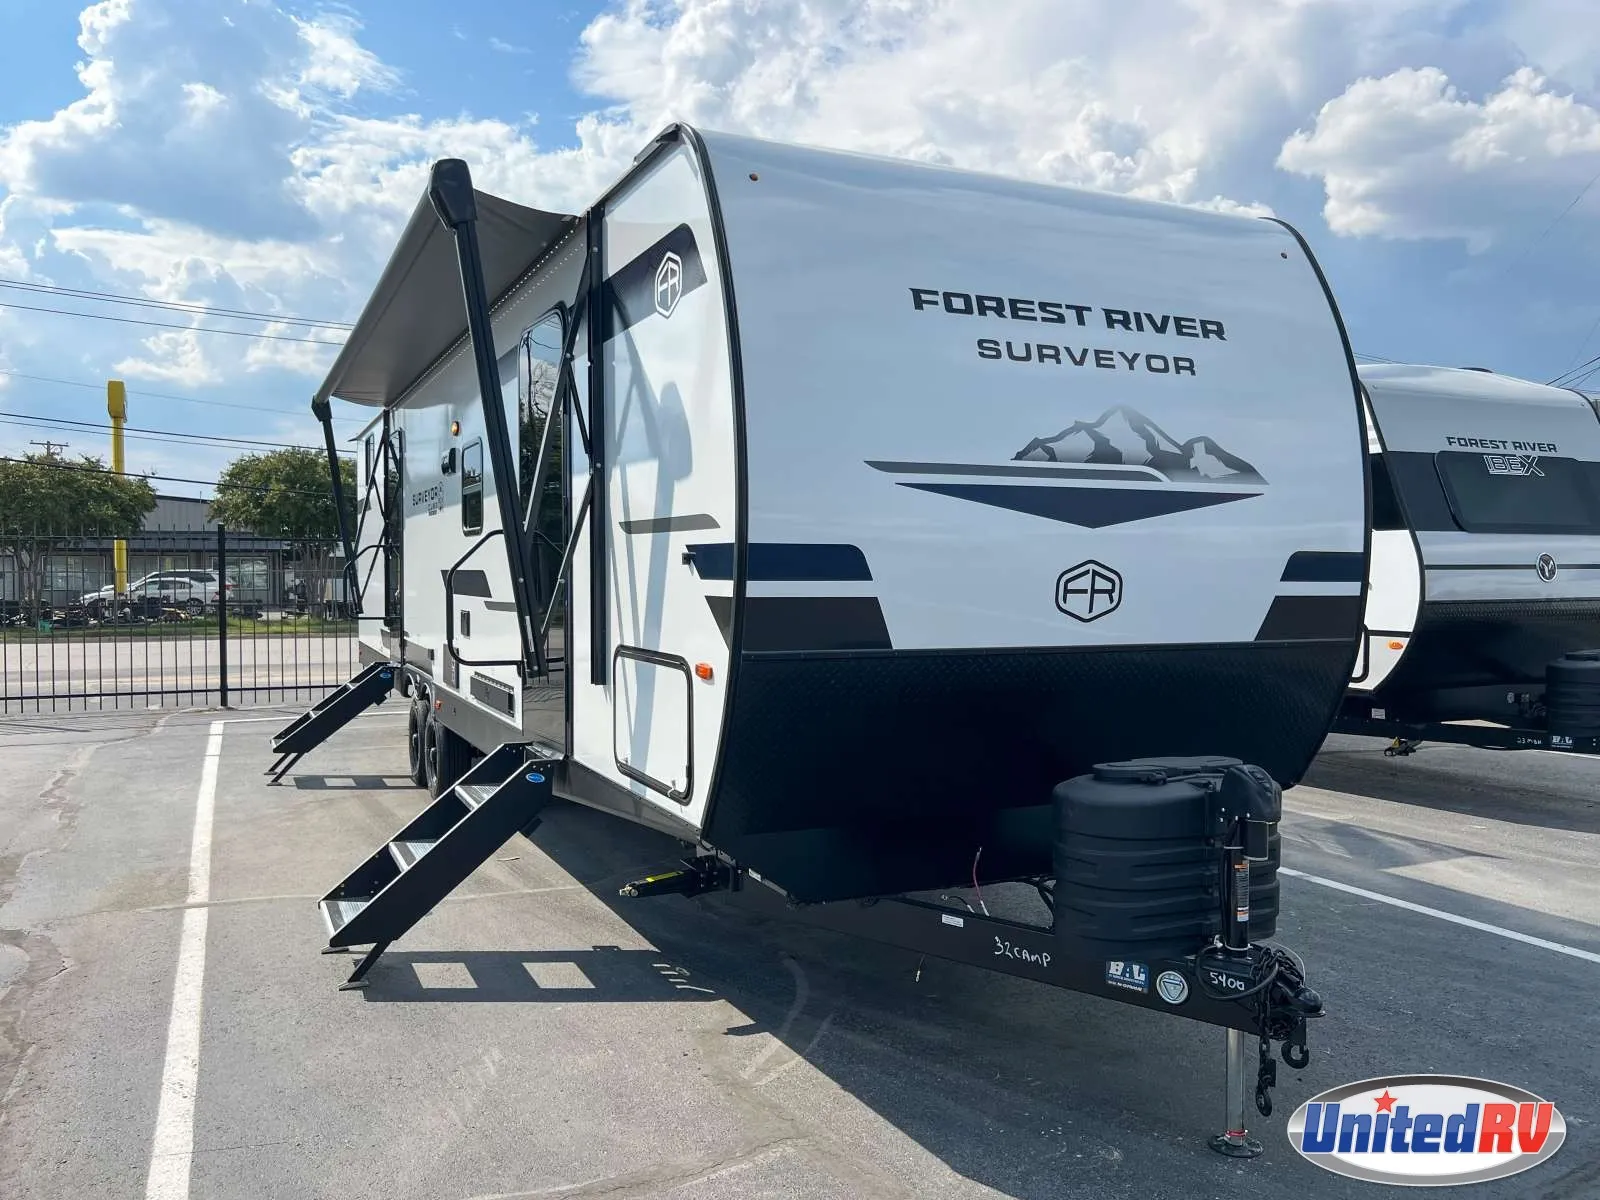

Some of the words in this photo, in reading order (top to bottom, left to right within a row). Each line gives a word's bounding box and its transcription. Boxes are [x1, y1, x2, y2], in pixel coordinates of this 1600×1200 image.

[908, 287, 1092, 327] FOREST
[1101, 307, 1228, 341] RIVER
[976, 338, 1197, 376] SURVEYOR
[1446, 436, 1508, 450] FOREST
[1511, 441, 1558, 453] RIVER
[1483, 454, 1545, 477] IBEX
[412, 485, 439, 506] SURVEYOR
[1210, 971, 1245, 991] 5400
